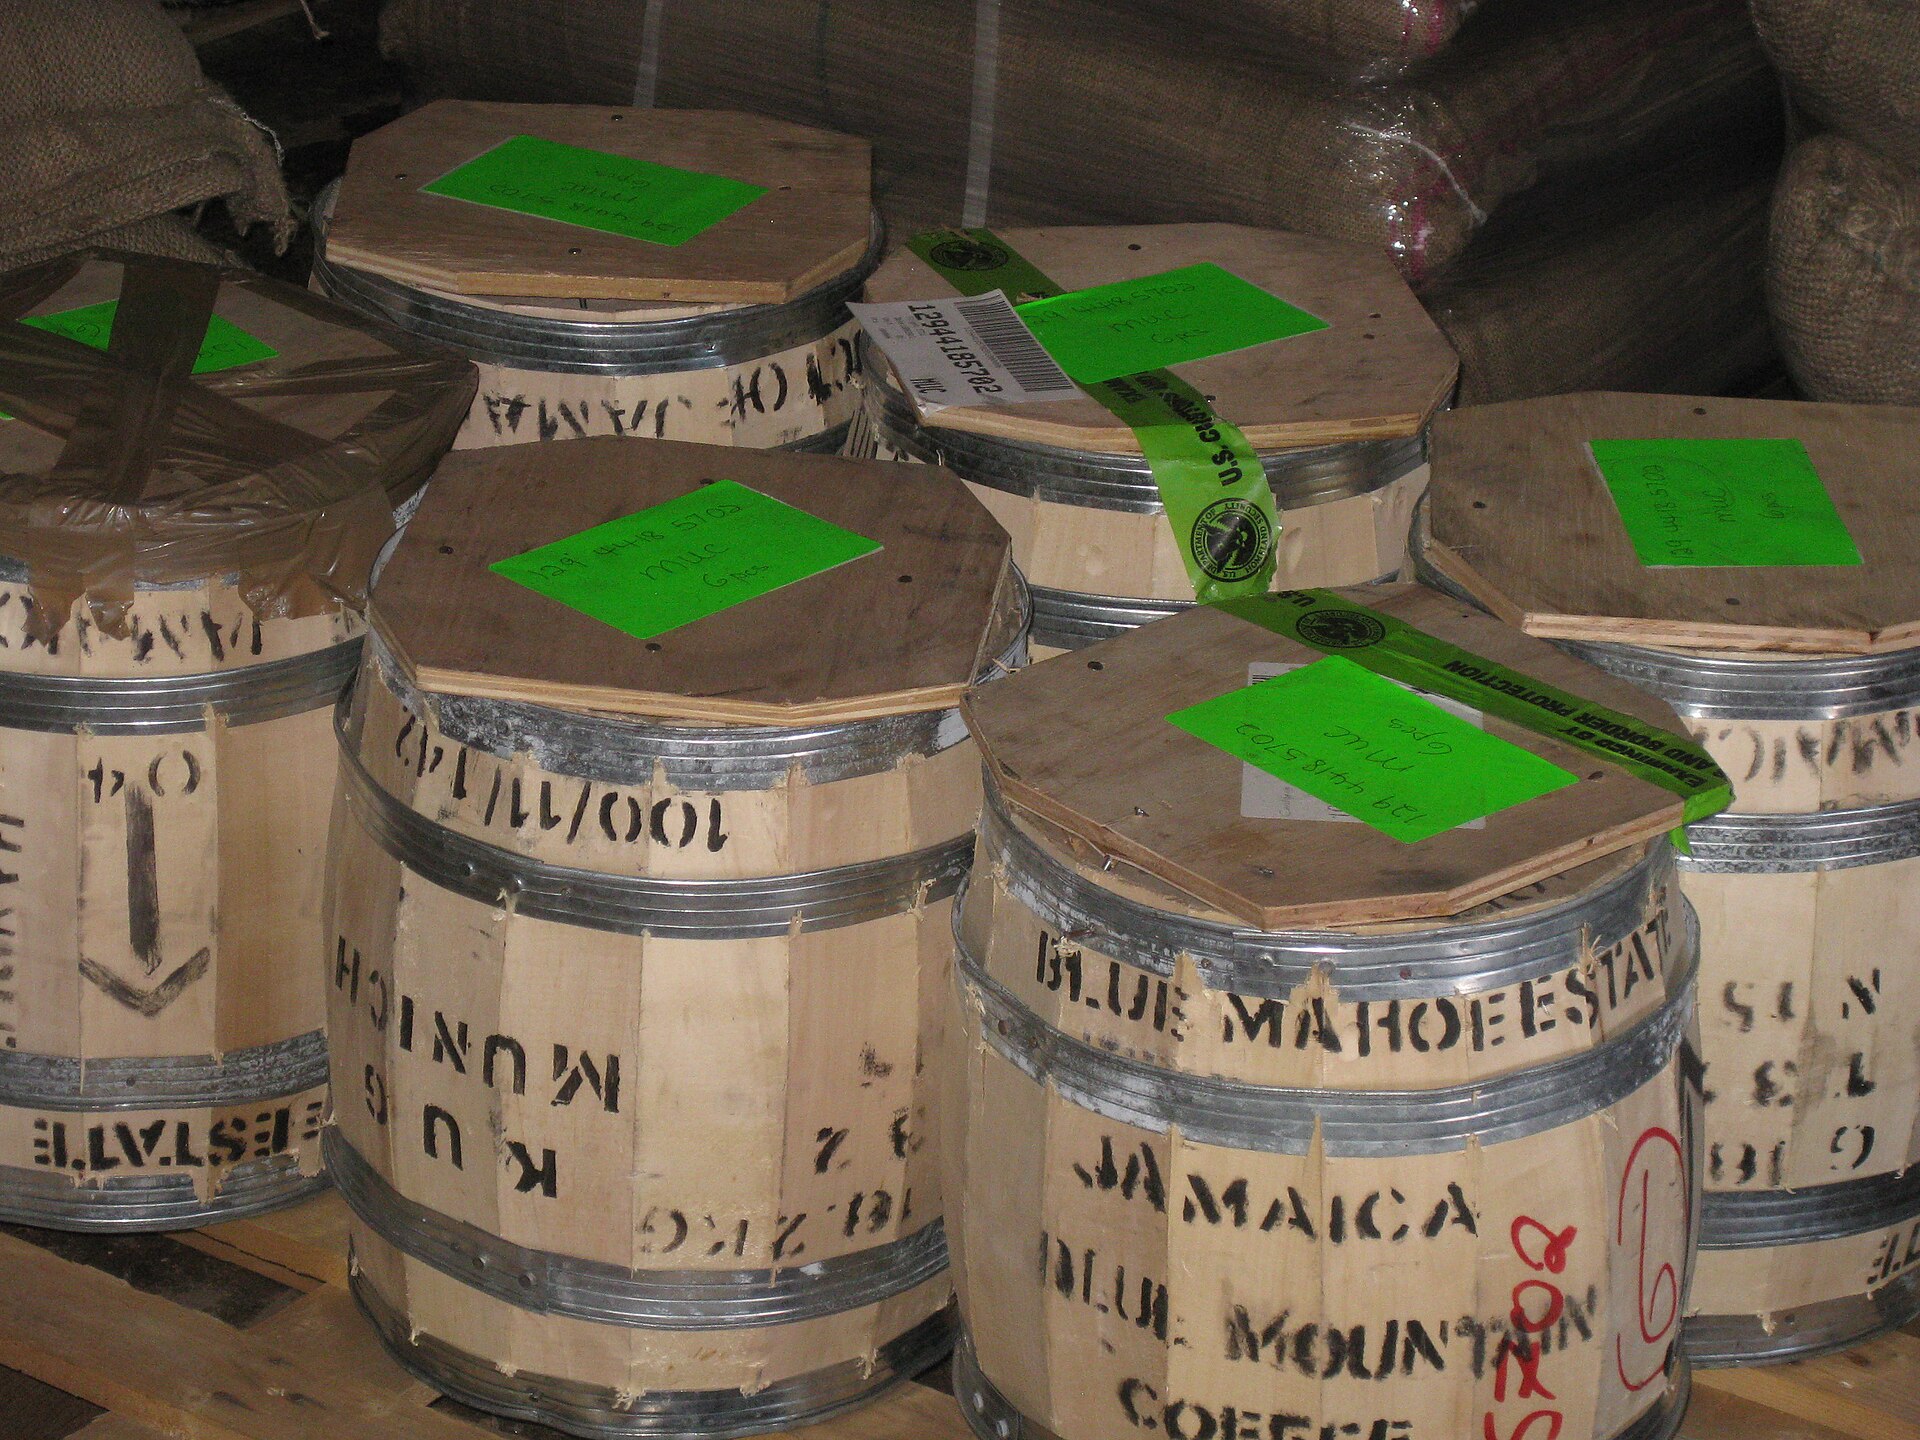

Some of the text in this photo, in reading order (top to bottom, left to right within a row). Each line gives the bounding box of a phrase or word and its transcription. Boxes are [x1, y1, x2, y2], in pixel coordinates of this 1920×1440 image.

[907, 304, 1003, 394] 12944185702
[911, 377, 947, 394] MUC
[1444, 659, 1581, 719] PROTECTION
[1558, 725, 1596, 742] BY
[1573, 711, 1666, 750] BORDER
[1372, 796, 1427, 824] 129
[335, 936, 620, 1113] MUNICH
[1037, 931, 1187, 1042] BLUE
[1223, 990, 1505, 1057] MAHOE
[34, 1107, 291, 1171] ESTATE
[1073, 1135, 1479, 1243] JAMAICA
[1224, 1284, 1597, 1380] MOUNTAIN
